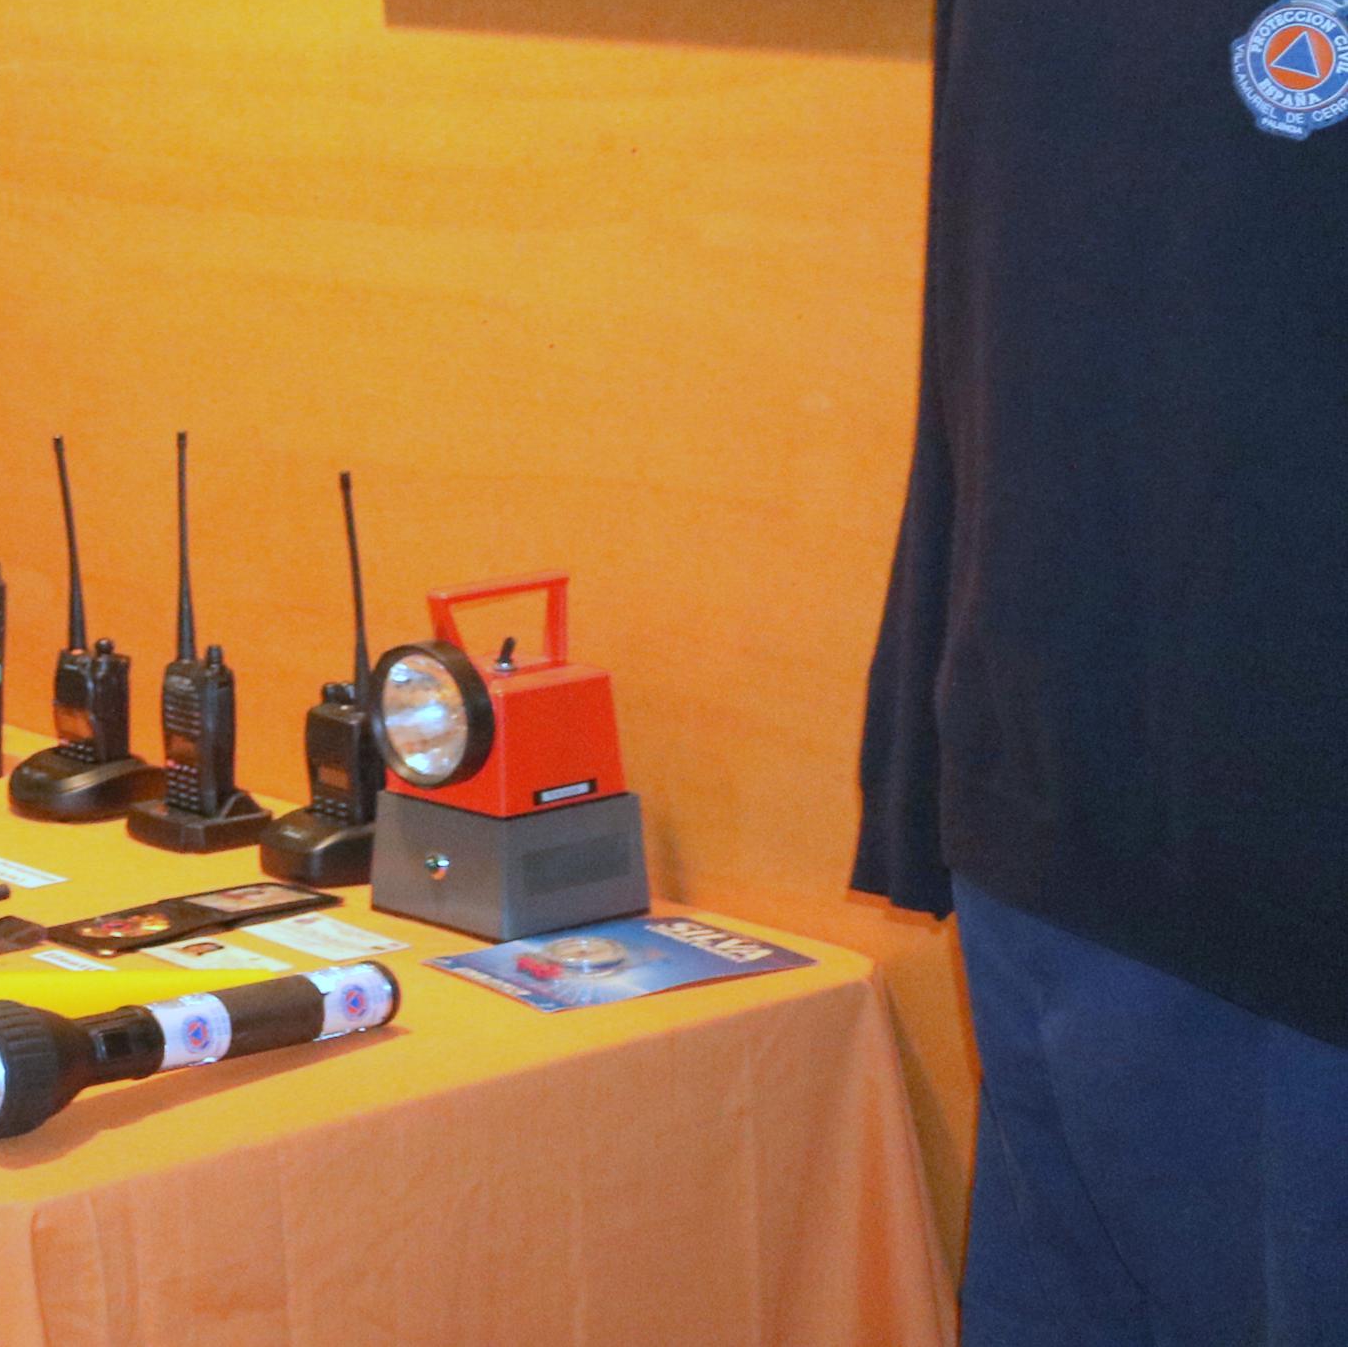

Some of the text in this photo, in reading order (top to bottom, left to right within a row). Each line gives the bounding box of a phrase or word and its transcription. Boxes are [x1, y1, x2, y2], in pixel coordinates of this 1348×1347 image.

[1250, 10, 1337, 53] PROTECCION
[1233, 43, 1278, 120] VILLAMURIEL
[1285, 112, 1305, 124] DE
[1258, 77, 1322, 108] ESPAÑA
[649, 922, 774, 963] SILVA
